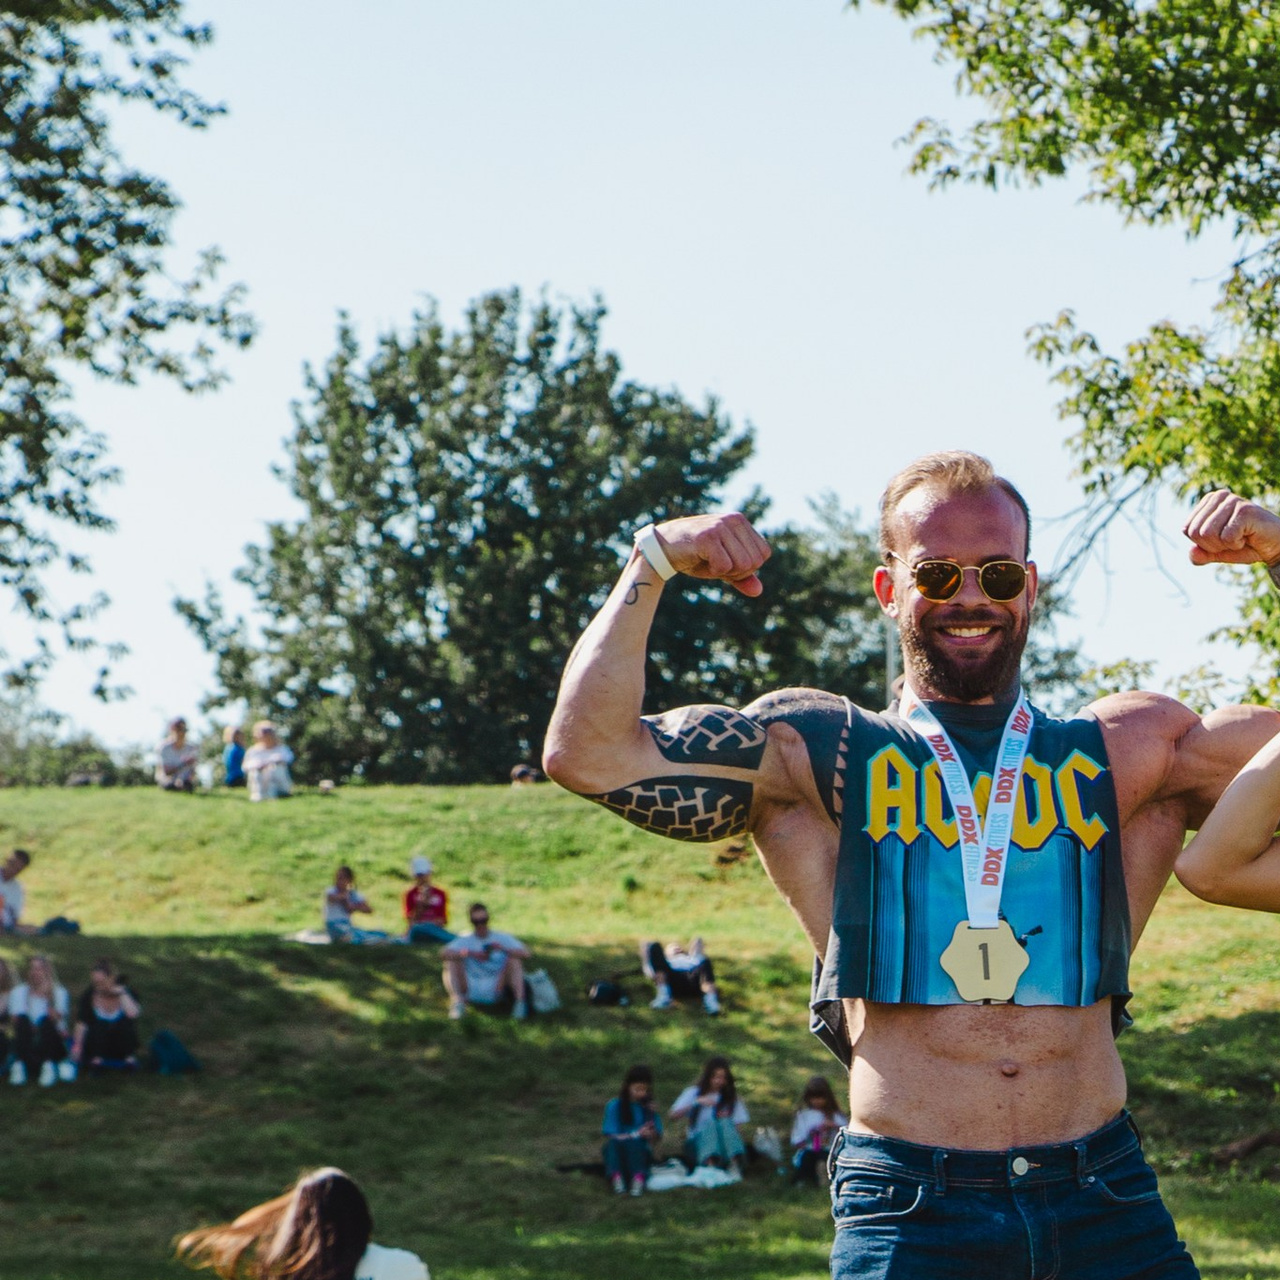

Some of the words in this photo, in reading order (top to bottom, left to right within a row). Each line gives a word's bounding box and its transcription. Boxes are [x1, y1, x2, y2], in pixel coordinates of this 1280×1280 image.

[1010, 705, 1032, 736] DDX
[1001, 738, 1024, 767] FITNESS
[926, 734, 957, 762] DDX
[956, 804, 979, 845] DDX
[994, 767, 1017, 803] DDX
[981, 847, 1004, 886] DDX
[978, 942, 990, 980] 1
